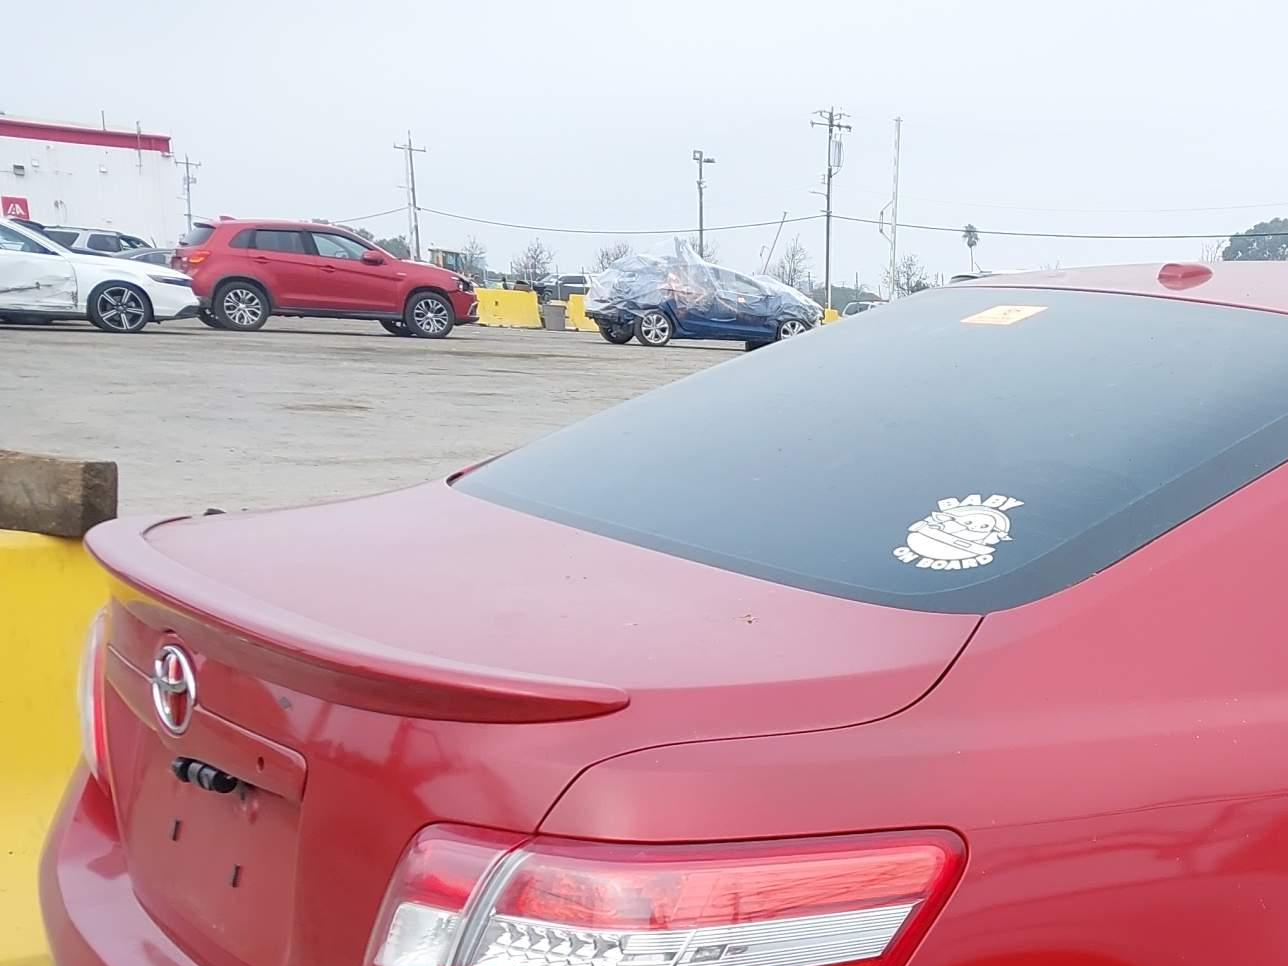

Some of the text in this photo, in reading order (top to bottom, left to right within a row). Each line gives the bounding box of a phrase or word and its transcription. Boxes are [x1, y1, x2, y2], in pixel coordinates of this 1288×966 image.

[937, 494, 1025, 511] BABY
[893, 546, 994, 570] ON BOARD
